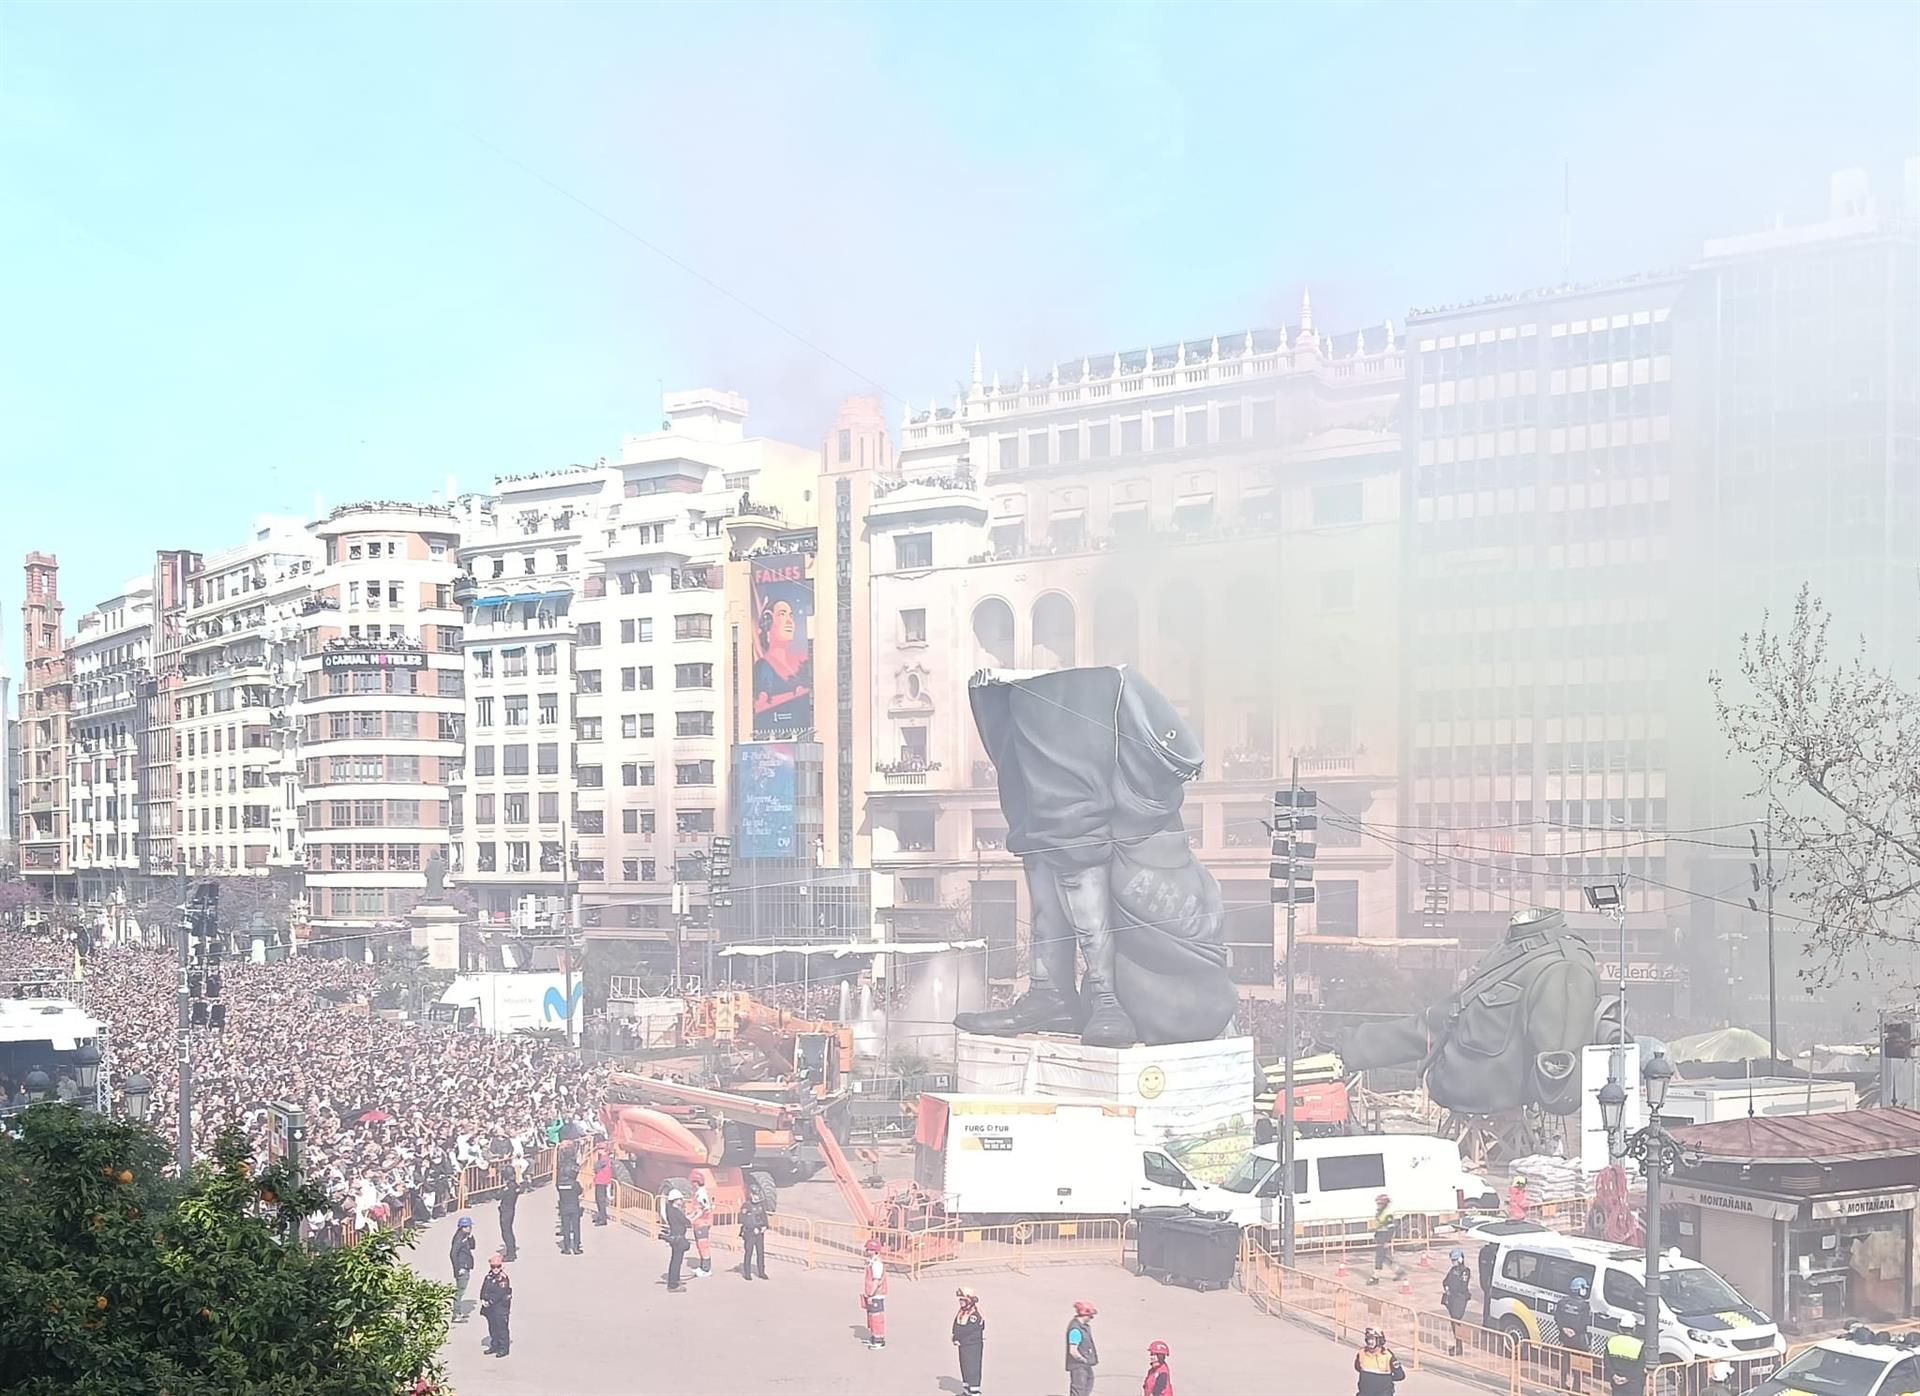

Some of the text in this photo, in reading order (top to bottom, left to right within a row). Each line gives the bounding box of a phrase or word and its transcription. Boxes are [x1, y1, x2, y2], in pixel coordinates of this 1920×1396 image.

[755, 566, 801, 583] FALLES
[332, 654, 369, 666] CASUAL
[1699, 1194, 1753, 1212] MONTAÑANA
